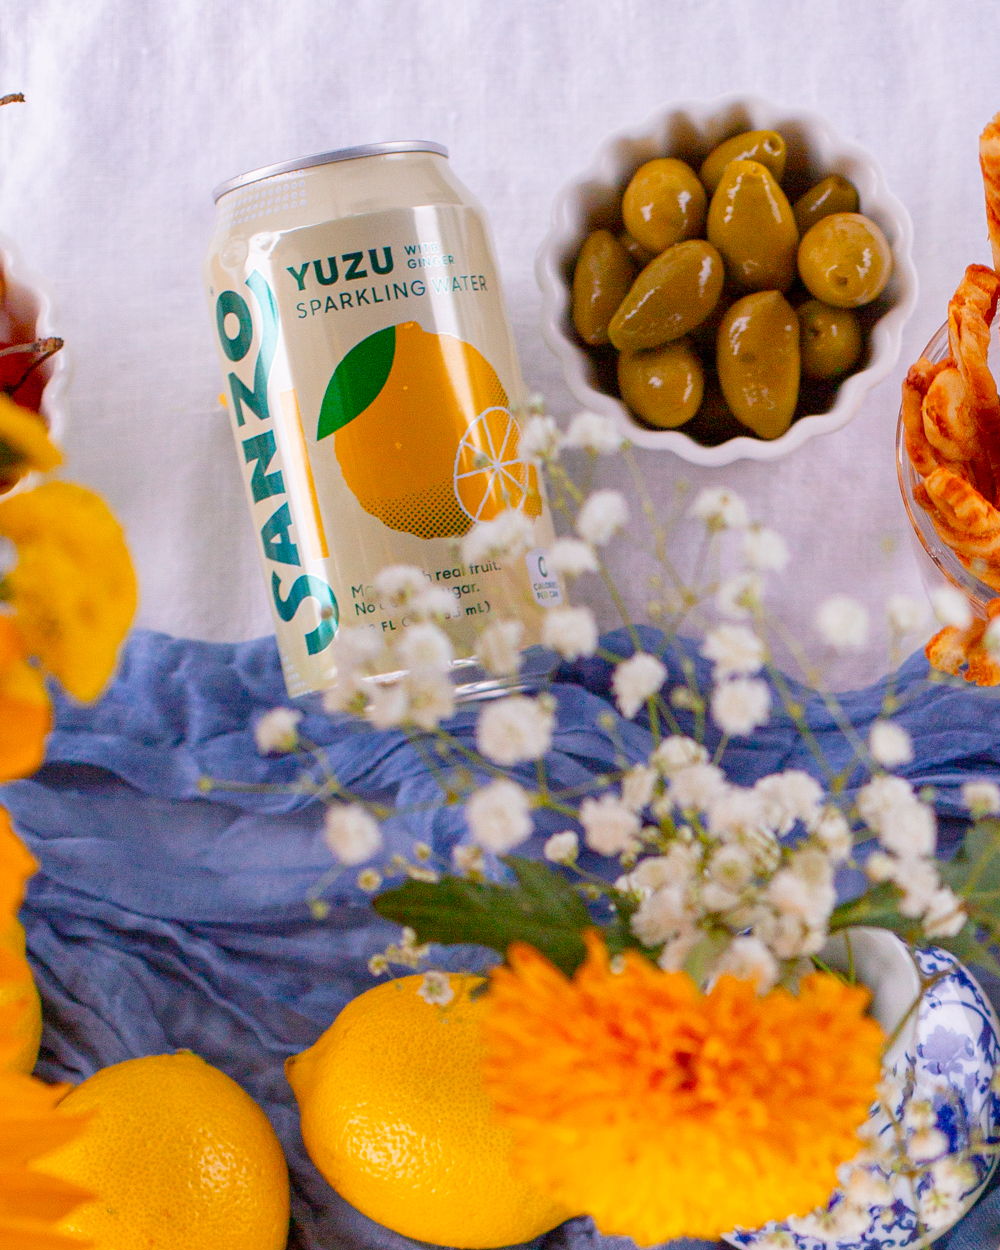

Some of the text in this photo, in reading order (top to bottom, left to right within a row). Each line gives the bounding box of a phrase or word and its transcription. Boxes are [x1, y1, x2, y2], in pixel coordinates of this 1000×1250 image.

[286, 246, 394, 291] YUZU
[407, 255, 455, 269] GINGER
[296, 275, 488, 319] SPARKLING WATER
[216, 269, 340, 656] SANZO
[469, 560, 502, 577] fruit.
[355, 602, 376, 616] No
